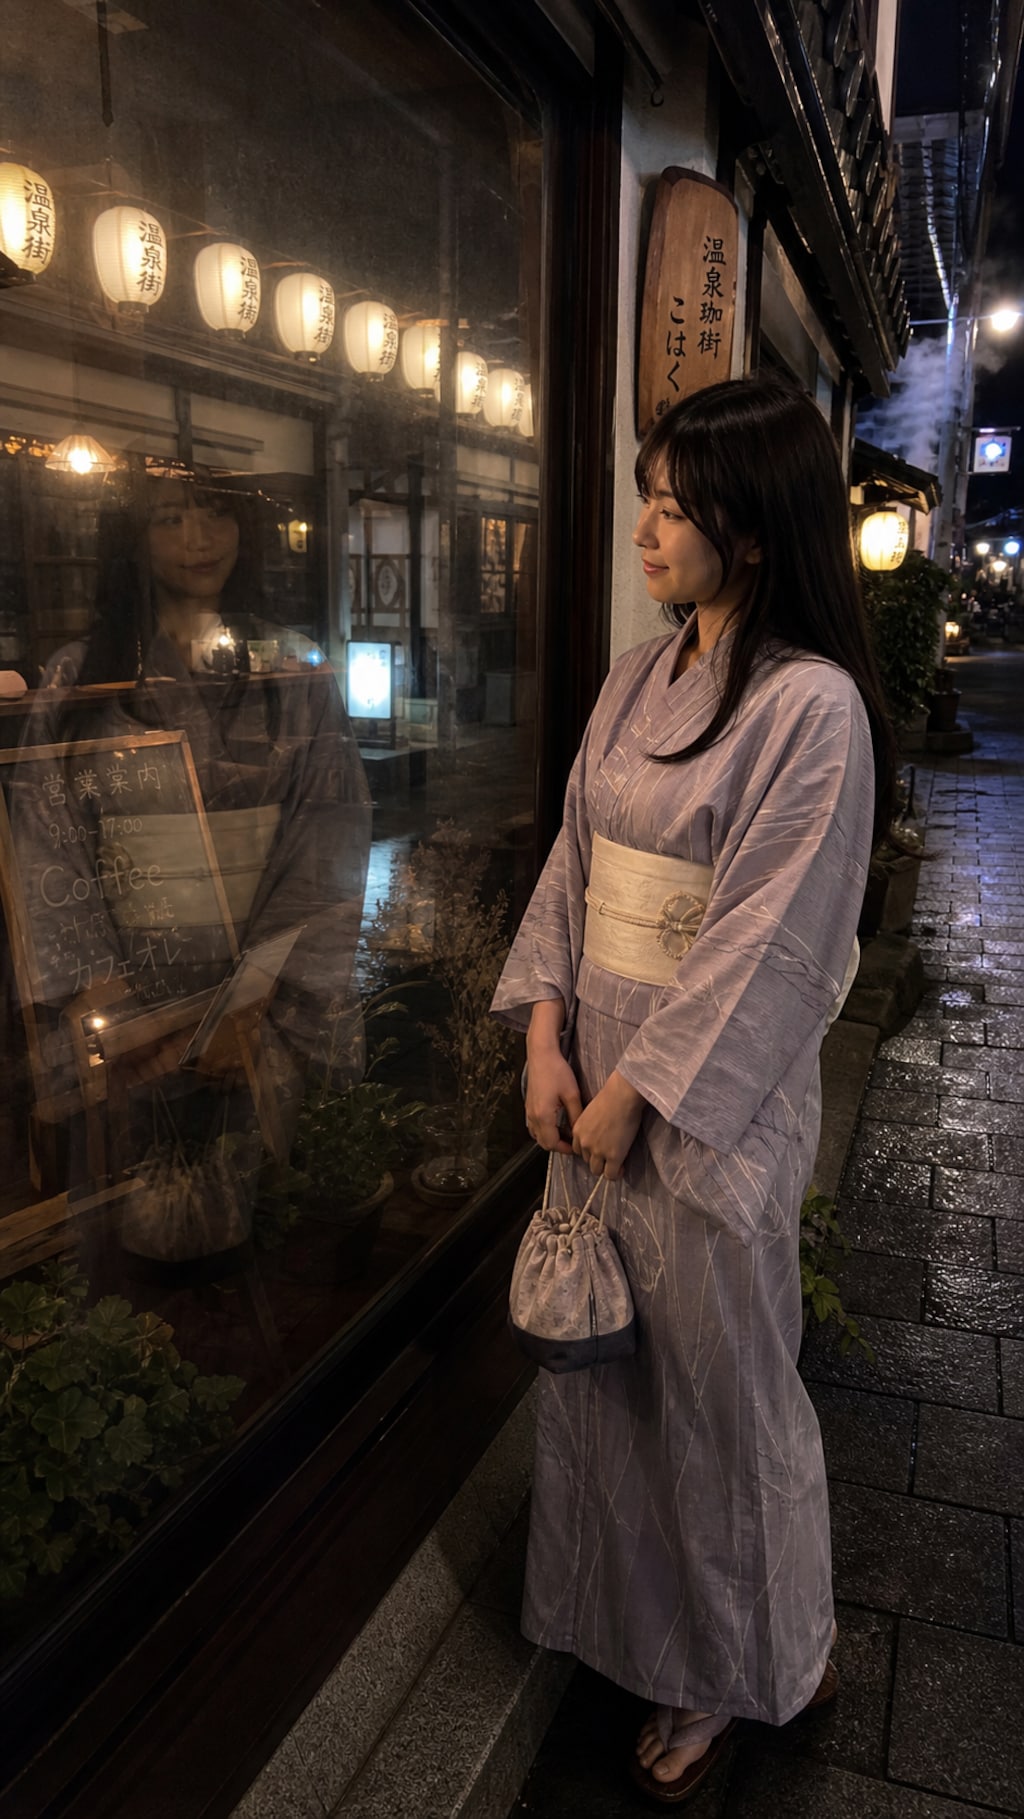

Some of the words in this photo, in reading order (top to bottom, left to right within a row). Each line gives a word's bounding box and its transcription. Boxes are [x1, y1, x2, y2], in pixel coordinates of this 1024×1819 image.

[22, 179, 52, 264] 温泉街
[137, 220, 164, 296] 温泉街
[238, 256, 259, 324] 温泉街
[697, 236, 726, 359] 温泉珈街
[666, 296, 687, 392] こはく
[40, 855, 164, 908] Coffee
